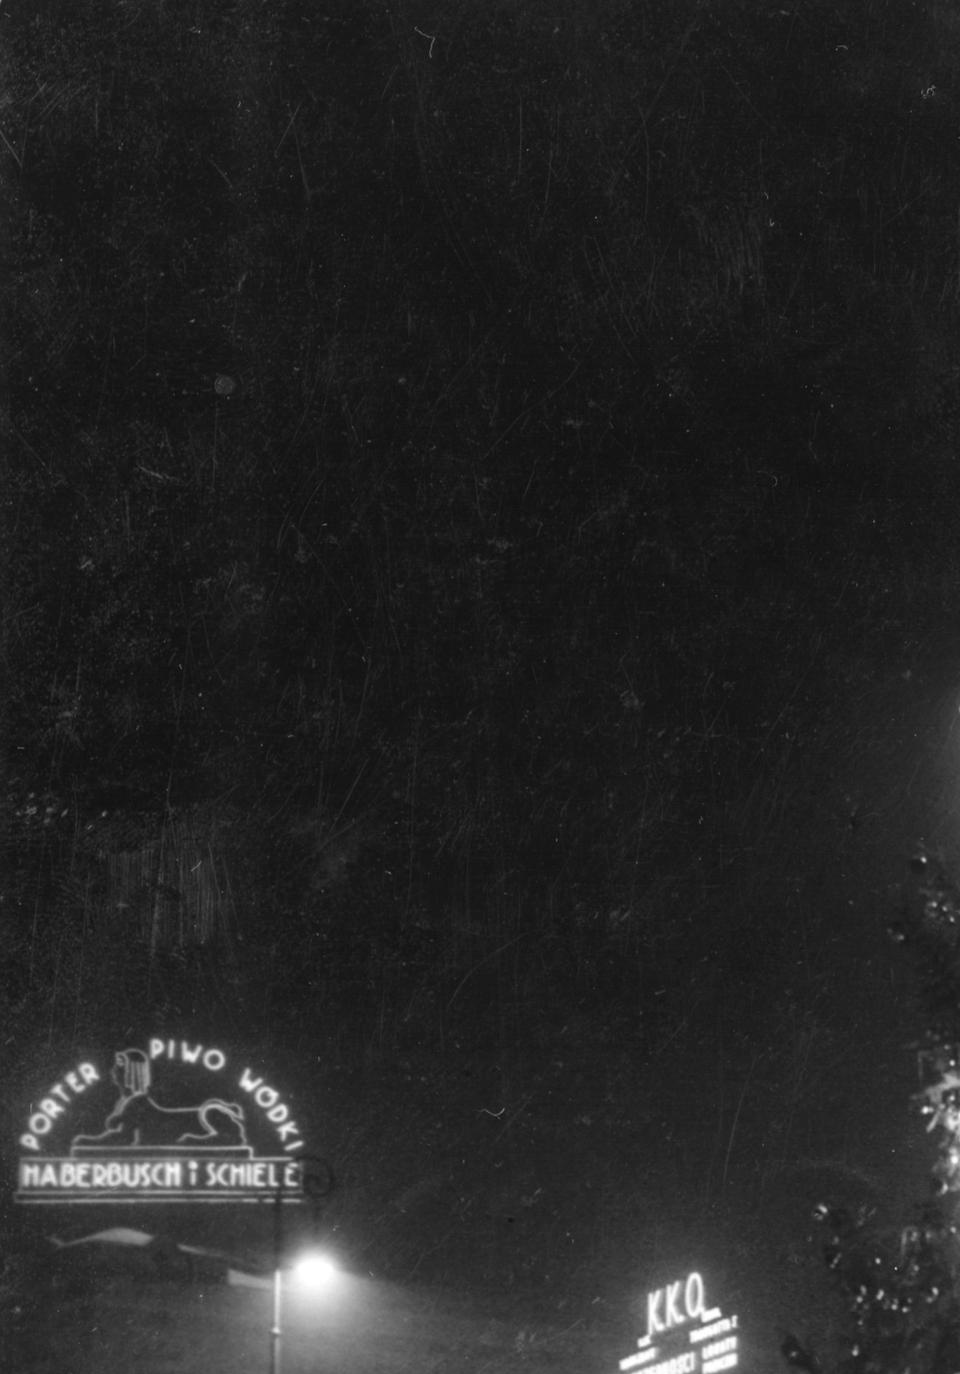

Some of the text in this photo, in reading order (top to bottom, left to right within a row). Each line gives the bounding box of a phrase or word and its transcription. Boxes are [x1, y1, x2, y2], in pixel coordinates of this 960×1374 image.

[149, 1038, 226, 1071] PIWO
[19, 1061, 100, 1151] PORTER
[22, 1162, 181, 1187] HABERBUSCH
[206, 1162, 299, 1187] SCHIELE
